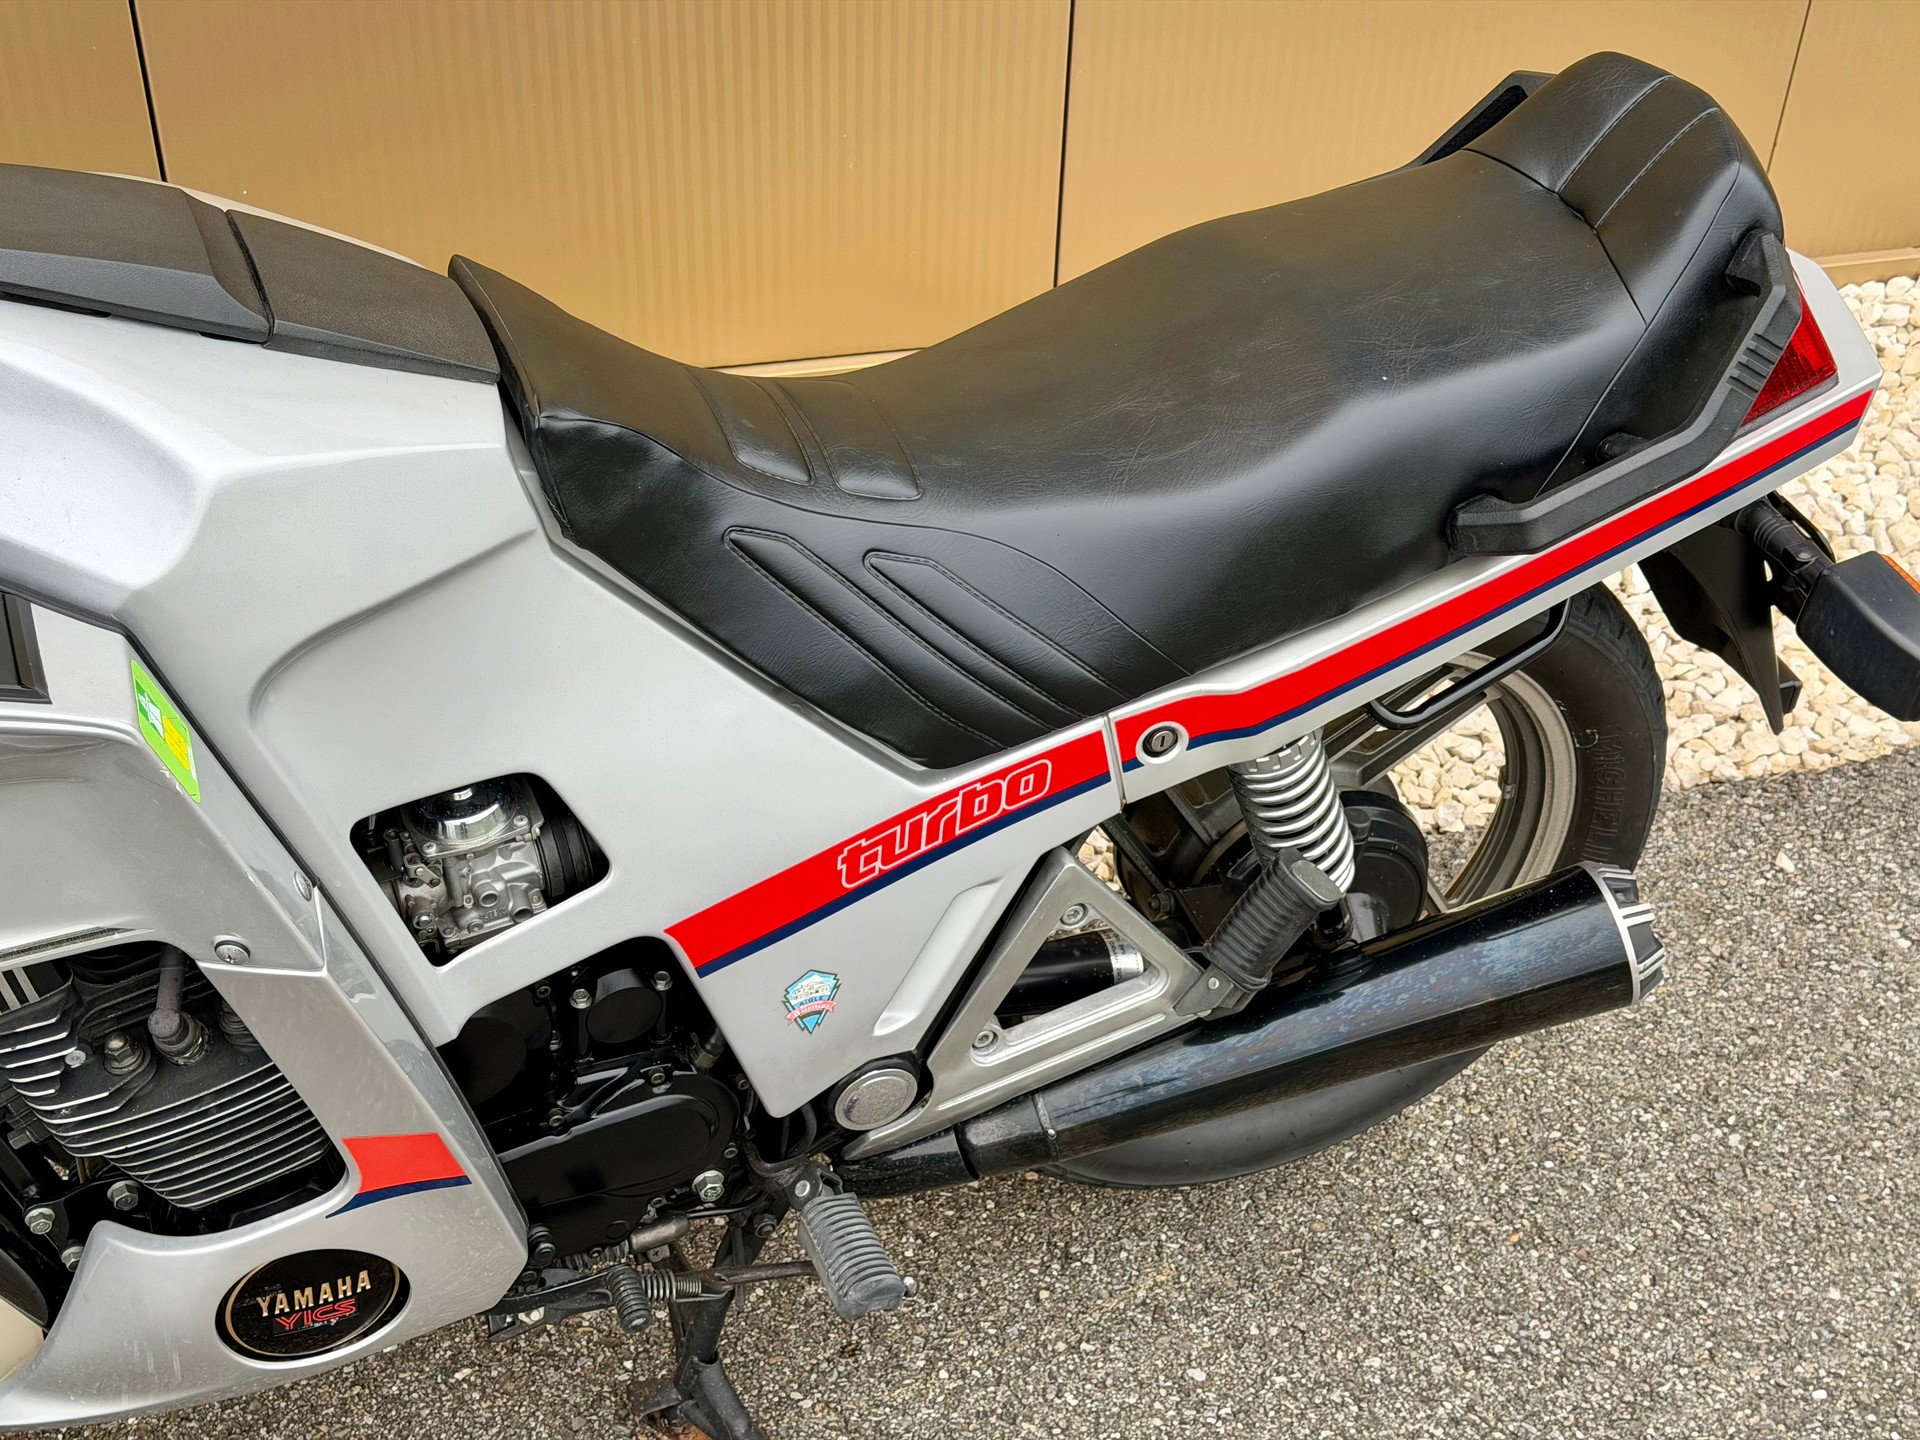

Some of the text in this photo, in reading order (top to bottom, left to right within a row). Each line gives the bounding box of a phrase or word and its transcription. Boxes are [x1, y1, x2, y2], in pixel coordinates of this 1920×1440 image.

[837, 759, 1052, 888] turbo
[256, 1269, 371, 1317] YAMAHA
[275, 1298, 356, 1330] YICS
